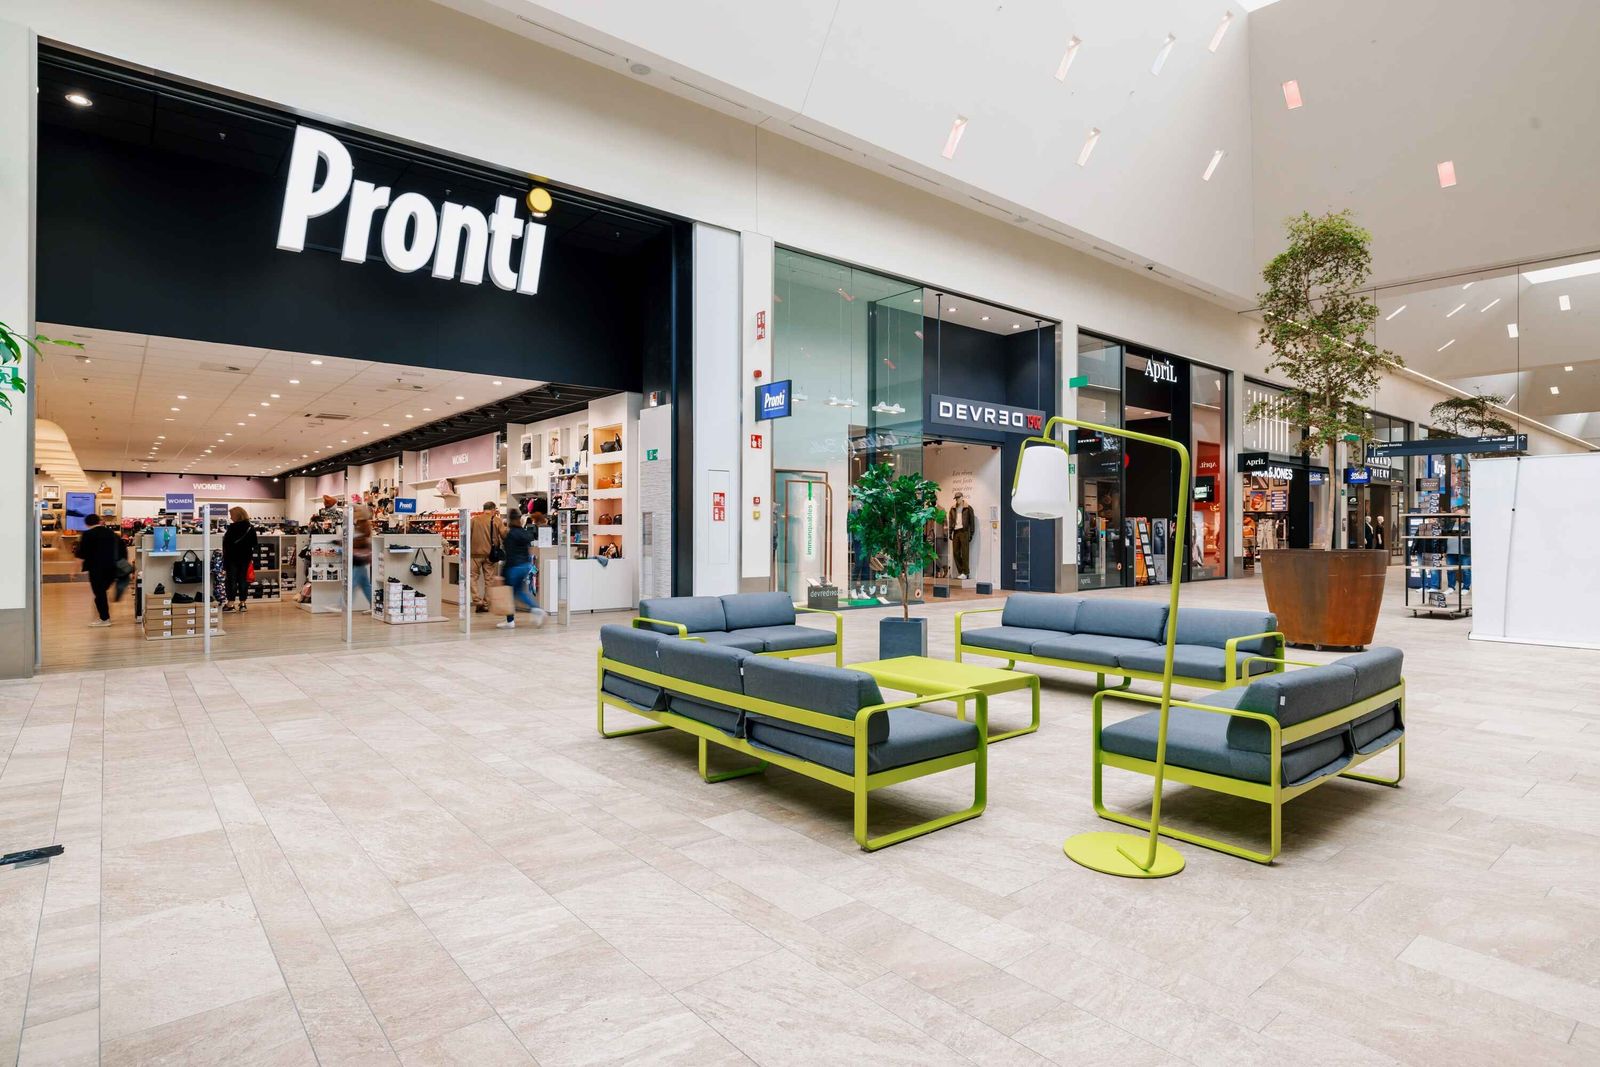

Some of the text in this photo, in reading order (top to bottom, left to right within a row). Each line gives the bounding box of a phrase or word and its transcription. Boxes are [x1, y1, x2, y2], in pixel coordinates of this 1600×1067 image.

[276, 124, 553, 296] Pronti
[764, 389, 786, 409] Pronti
[452, 453, 469, 465] WOMEN
[1370, 467, 1390, 479] HIERY
[193, 482, 226, 491] WOMEN
